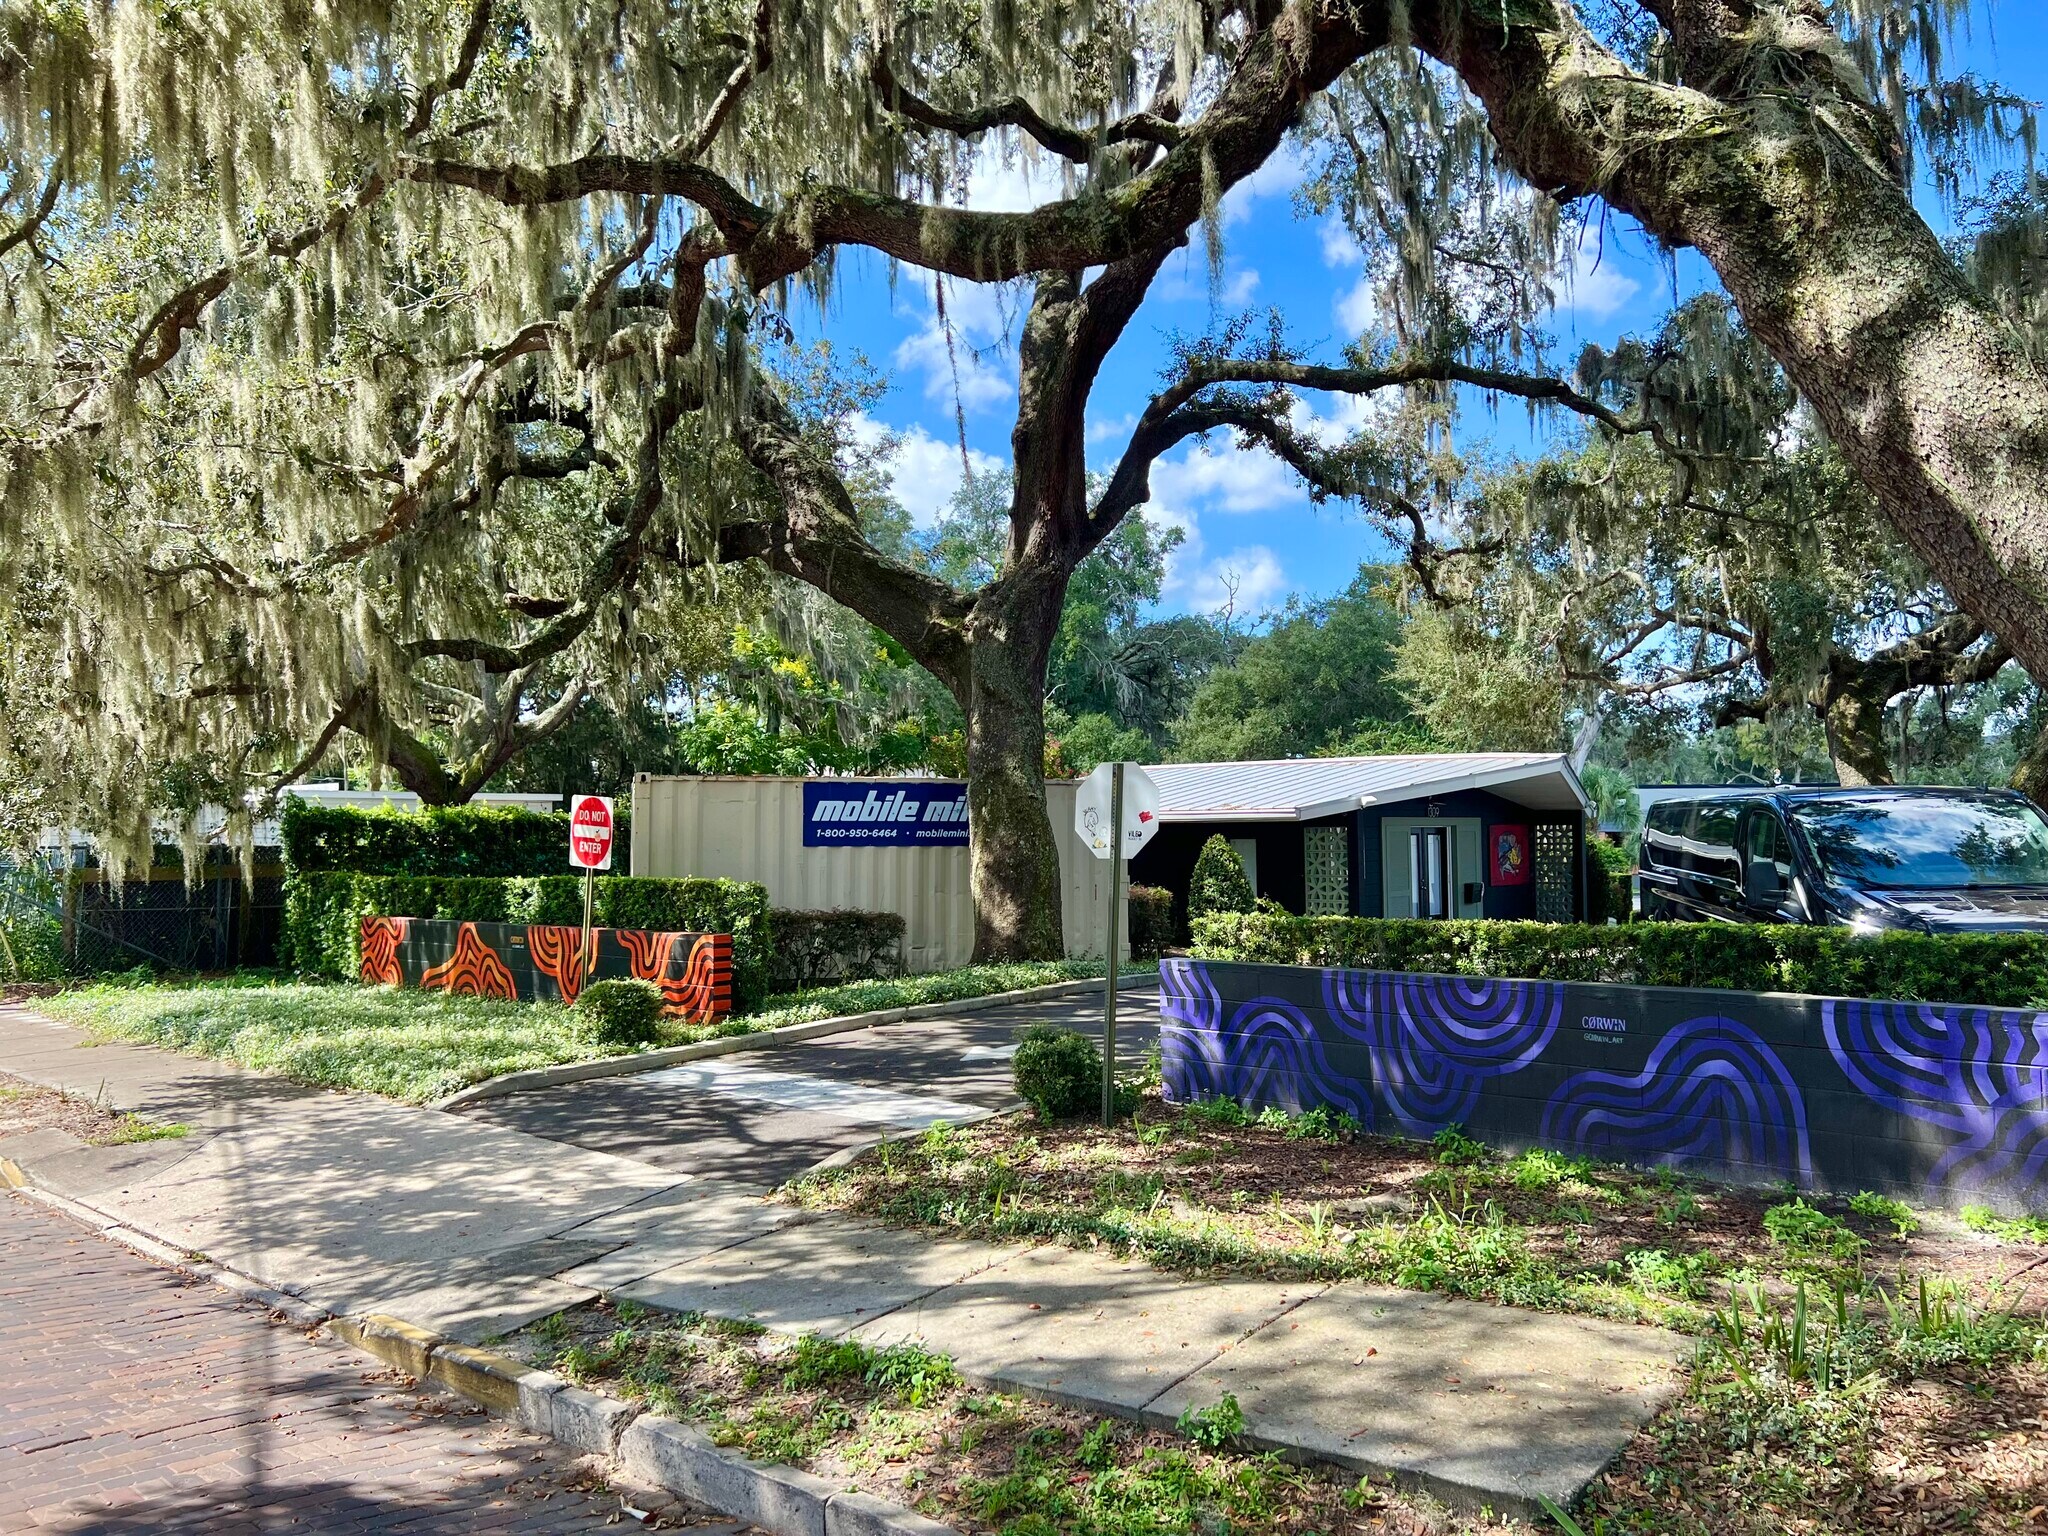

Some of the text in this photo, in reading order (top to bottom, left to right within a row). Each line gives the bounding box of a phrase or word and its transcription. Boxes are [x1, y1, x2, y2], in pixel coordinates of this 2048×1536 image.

[812, 790, 920, 821] mobile
[579, 810, 605, 822] DO NOT
[816, 829, 897, 837] 1-800-950-6464
[579, 841, 602, 854] ENTER
